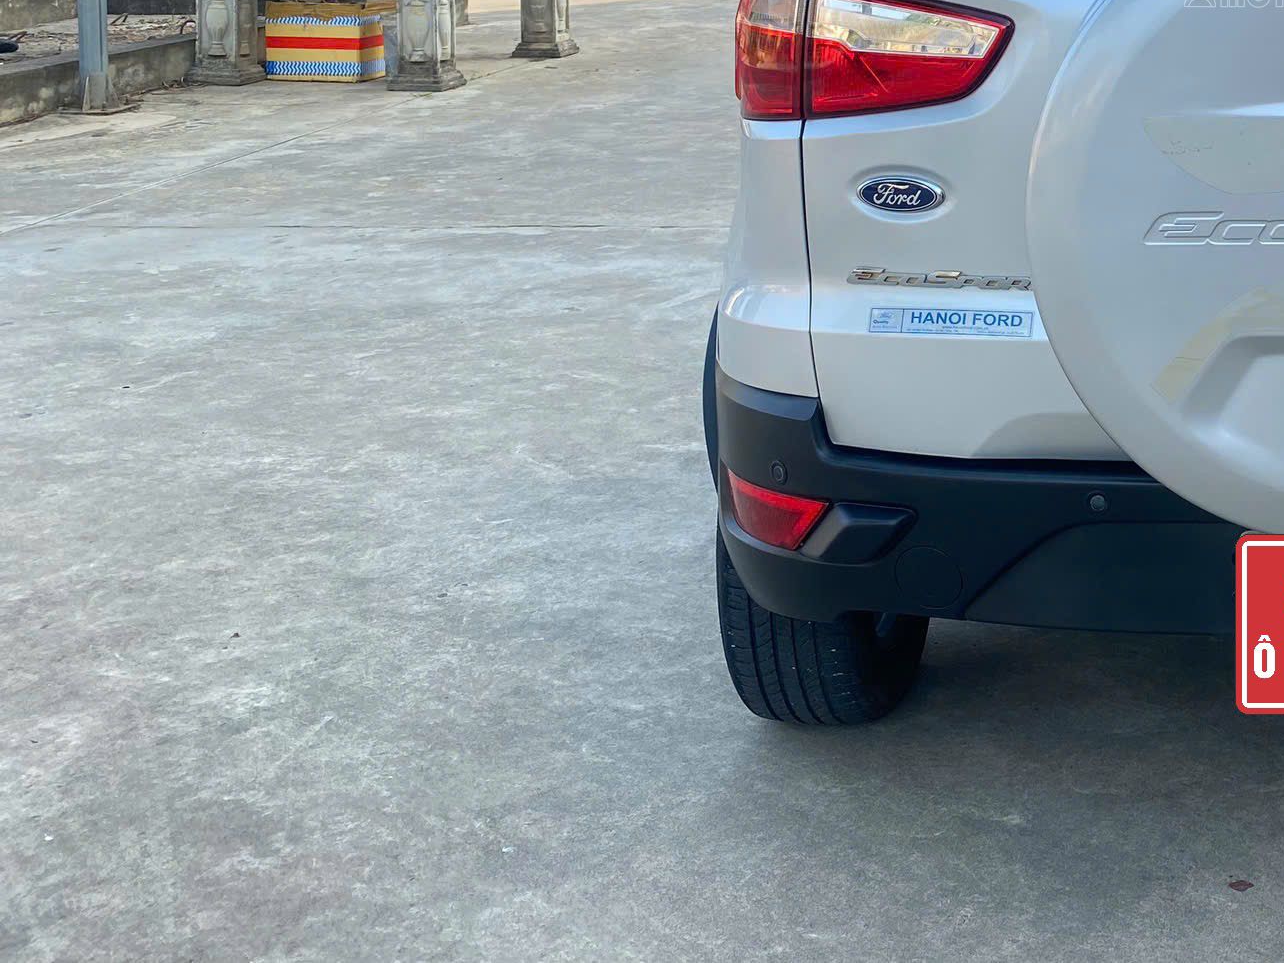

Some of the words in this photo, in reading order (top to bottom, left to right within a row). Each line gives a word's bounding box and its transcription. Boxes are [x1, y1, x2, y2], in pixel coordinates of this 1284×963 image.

[873, 182, 922, 207] Ford
[910, 311, 968, 326] HANOI
[972, 313, 1024, 328] FORD
